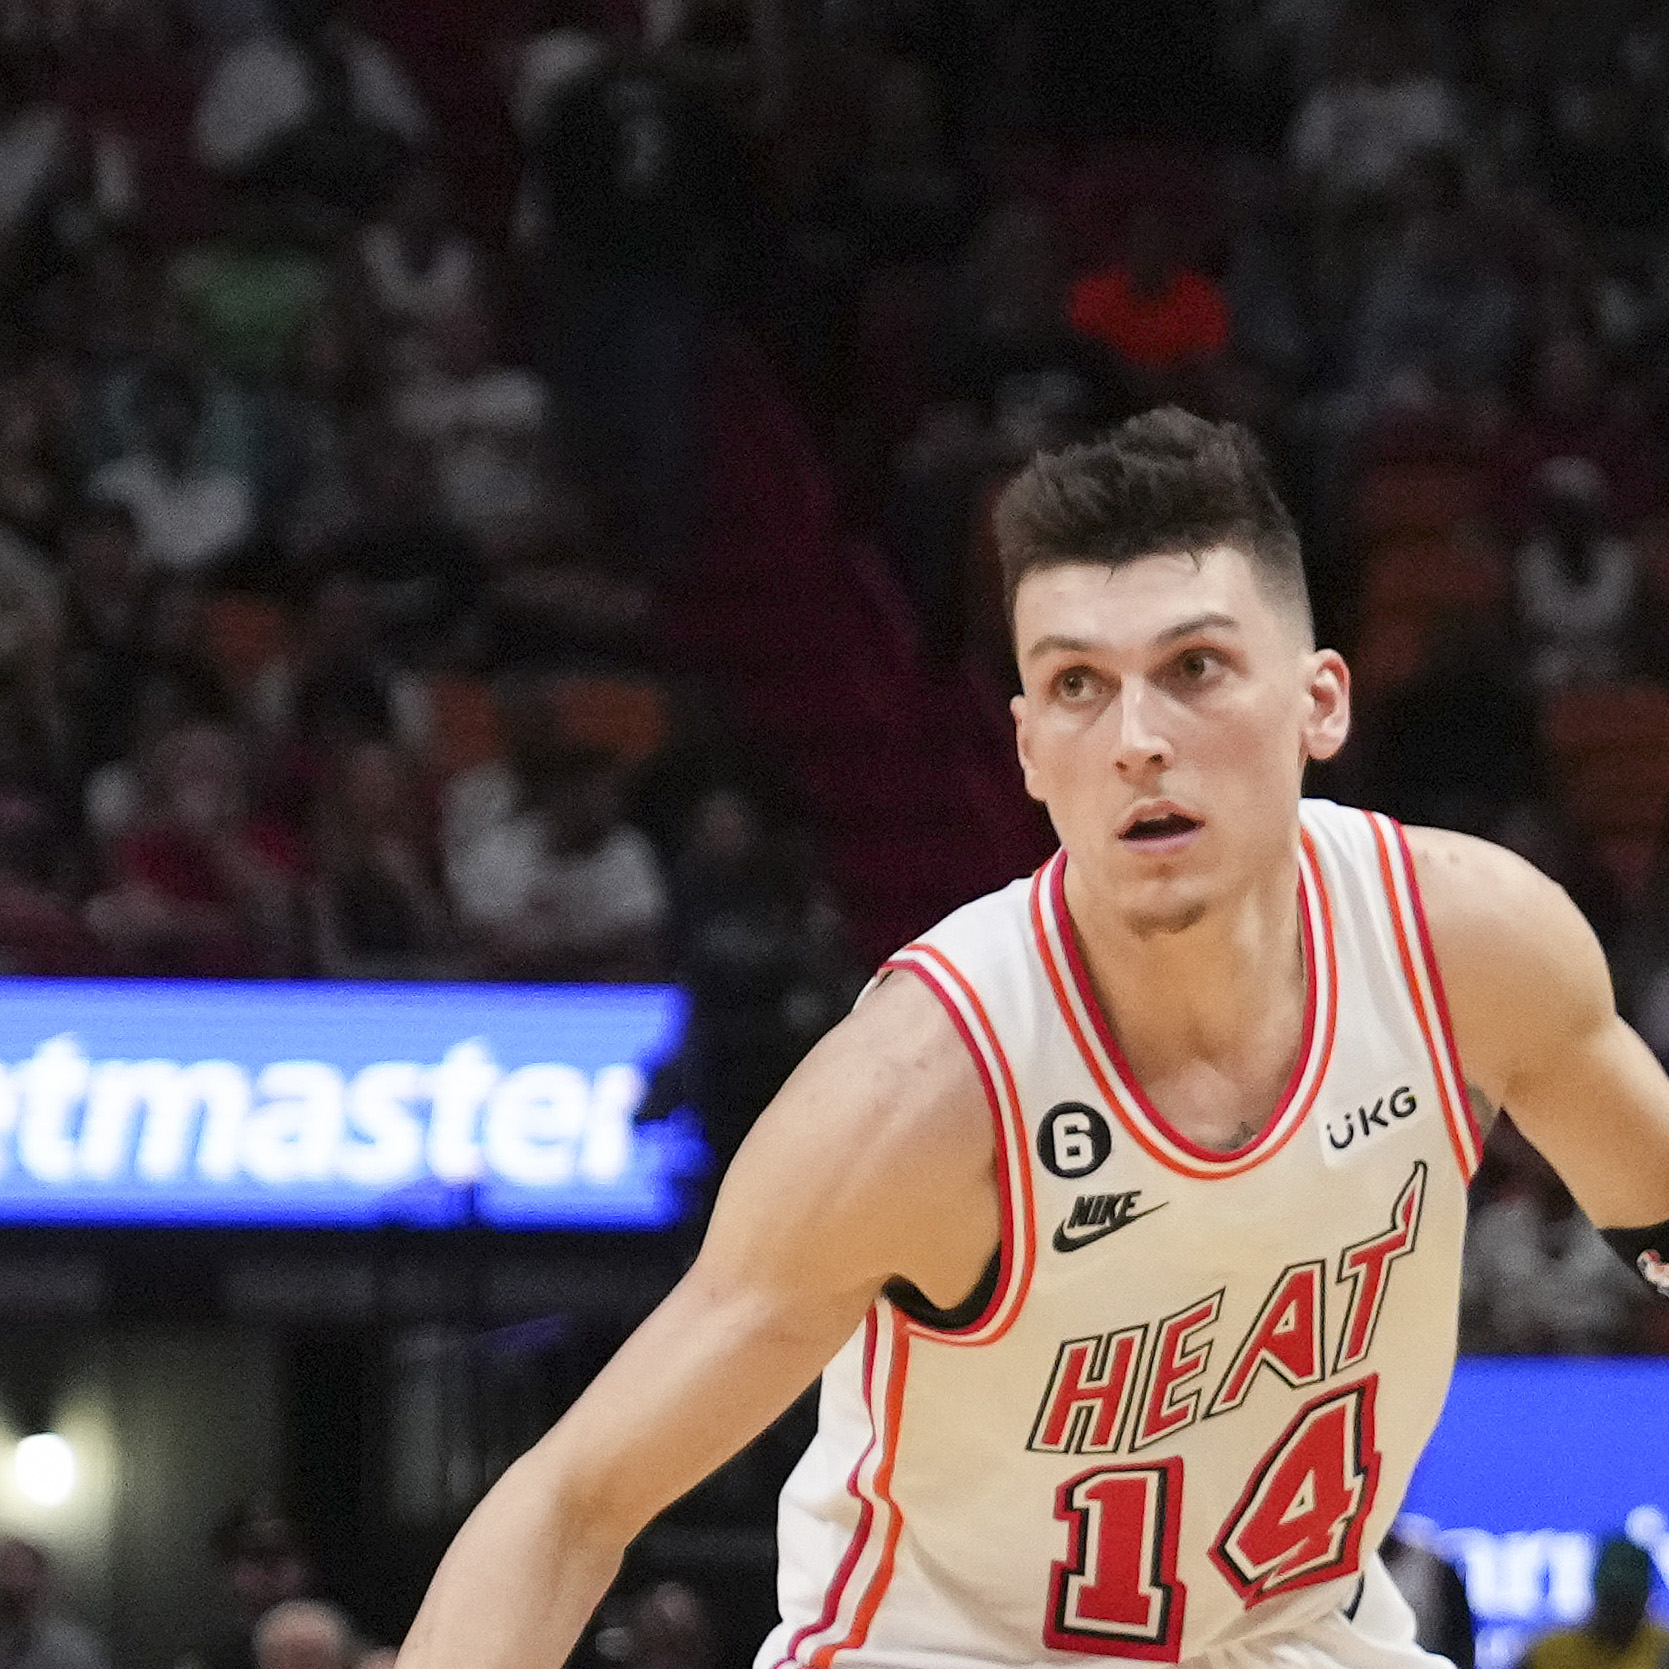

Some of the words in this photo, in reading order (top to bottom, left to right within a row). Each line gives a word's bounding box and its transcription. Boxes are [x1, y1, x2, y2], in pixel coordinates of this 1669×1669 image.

[1053, 1112, 1096, 1171] 6
[1067, 1190, 1142, 1228] NIKE
[1025, 1160, 1427, 1455] HEAT
[1041, 1372, 1382, 1664] 14
